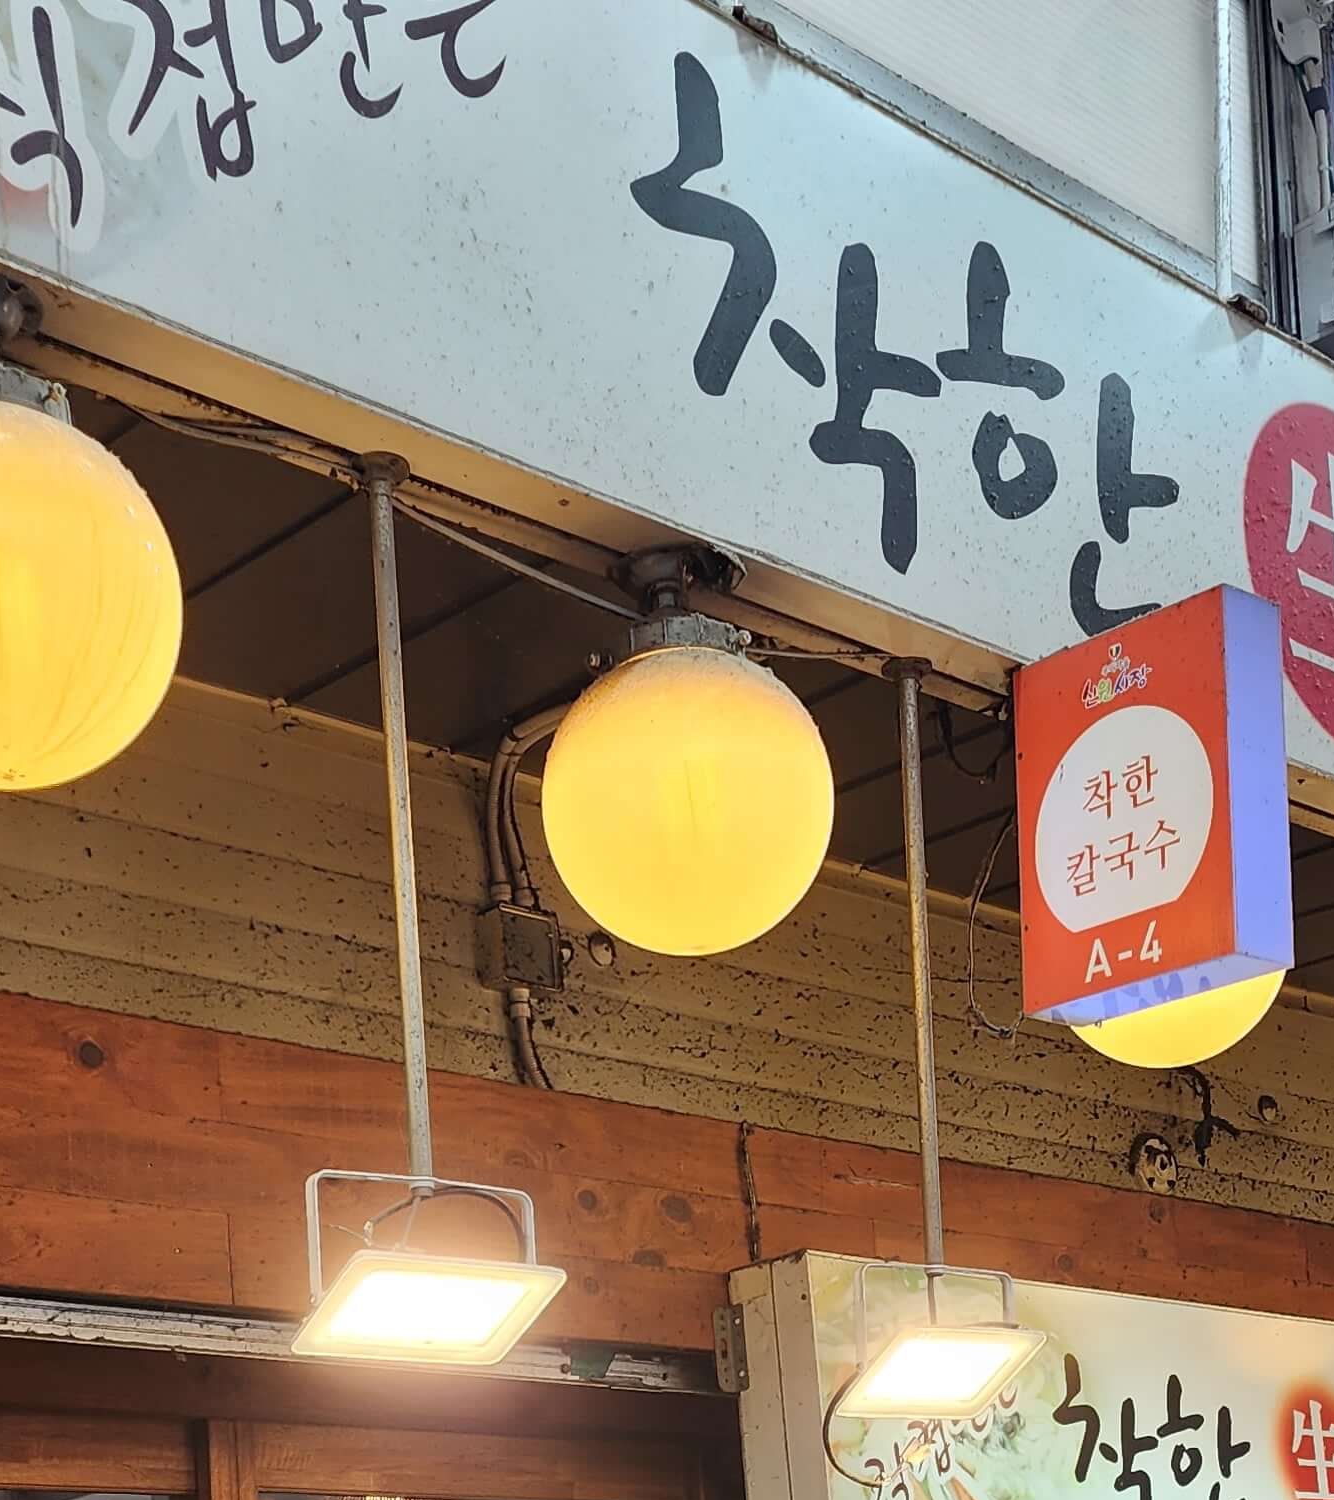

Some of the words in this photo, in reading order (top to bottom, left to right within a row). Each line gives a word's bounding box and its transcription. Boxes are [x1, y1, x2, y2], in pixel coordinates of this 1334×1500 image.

[630, 52, 1179, 637] 착한
[1082, 755, 1159, 820] 착한
[1067, 819, 1182, 898] 칼국수
[1084, 919, 1164, 984] A-4
